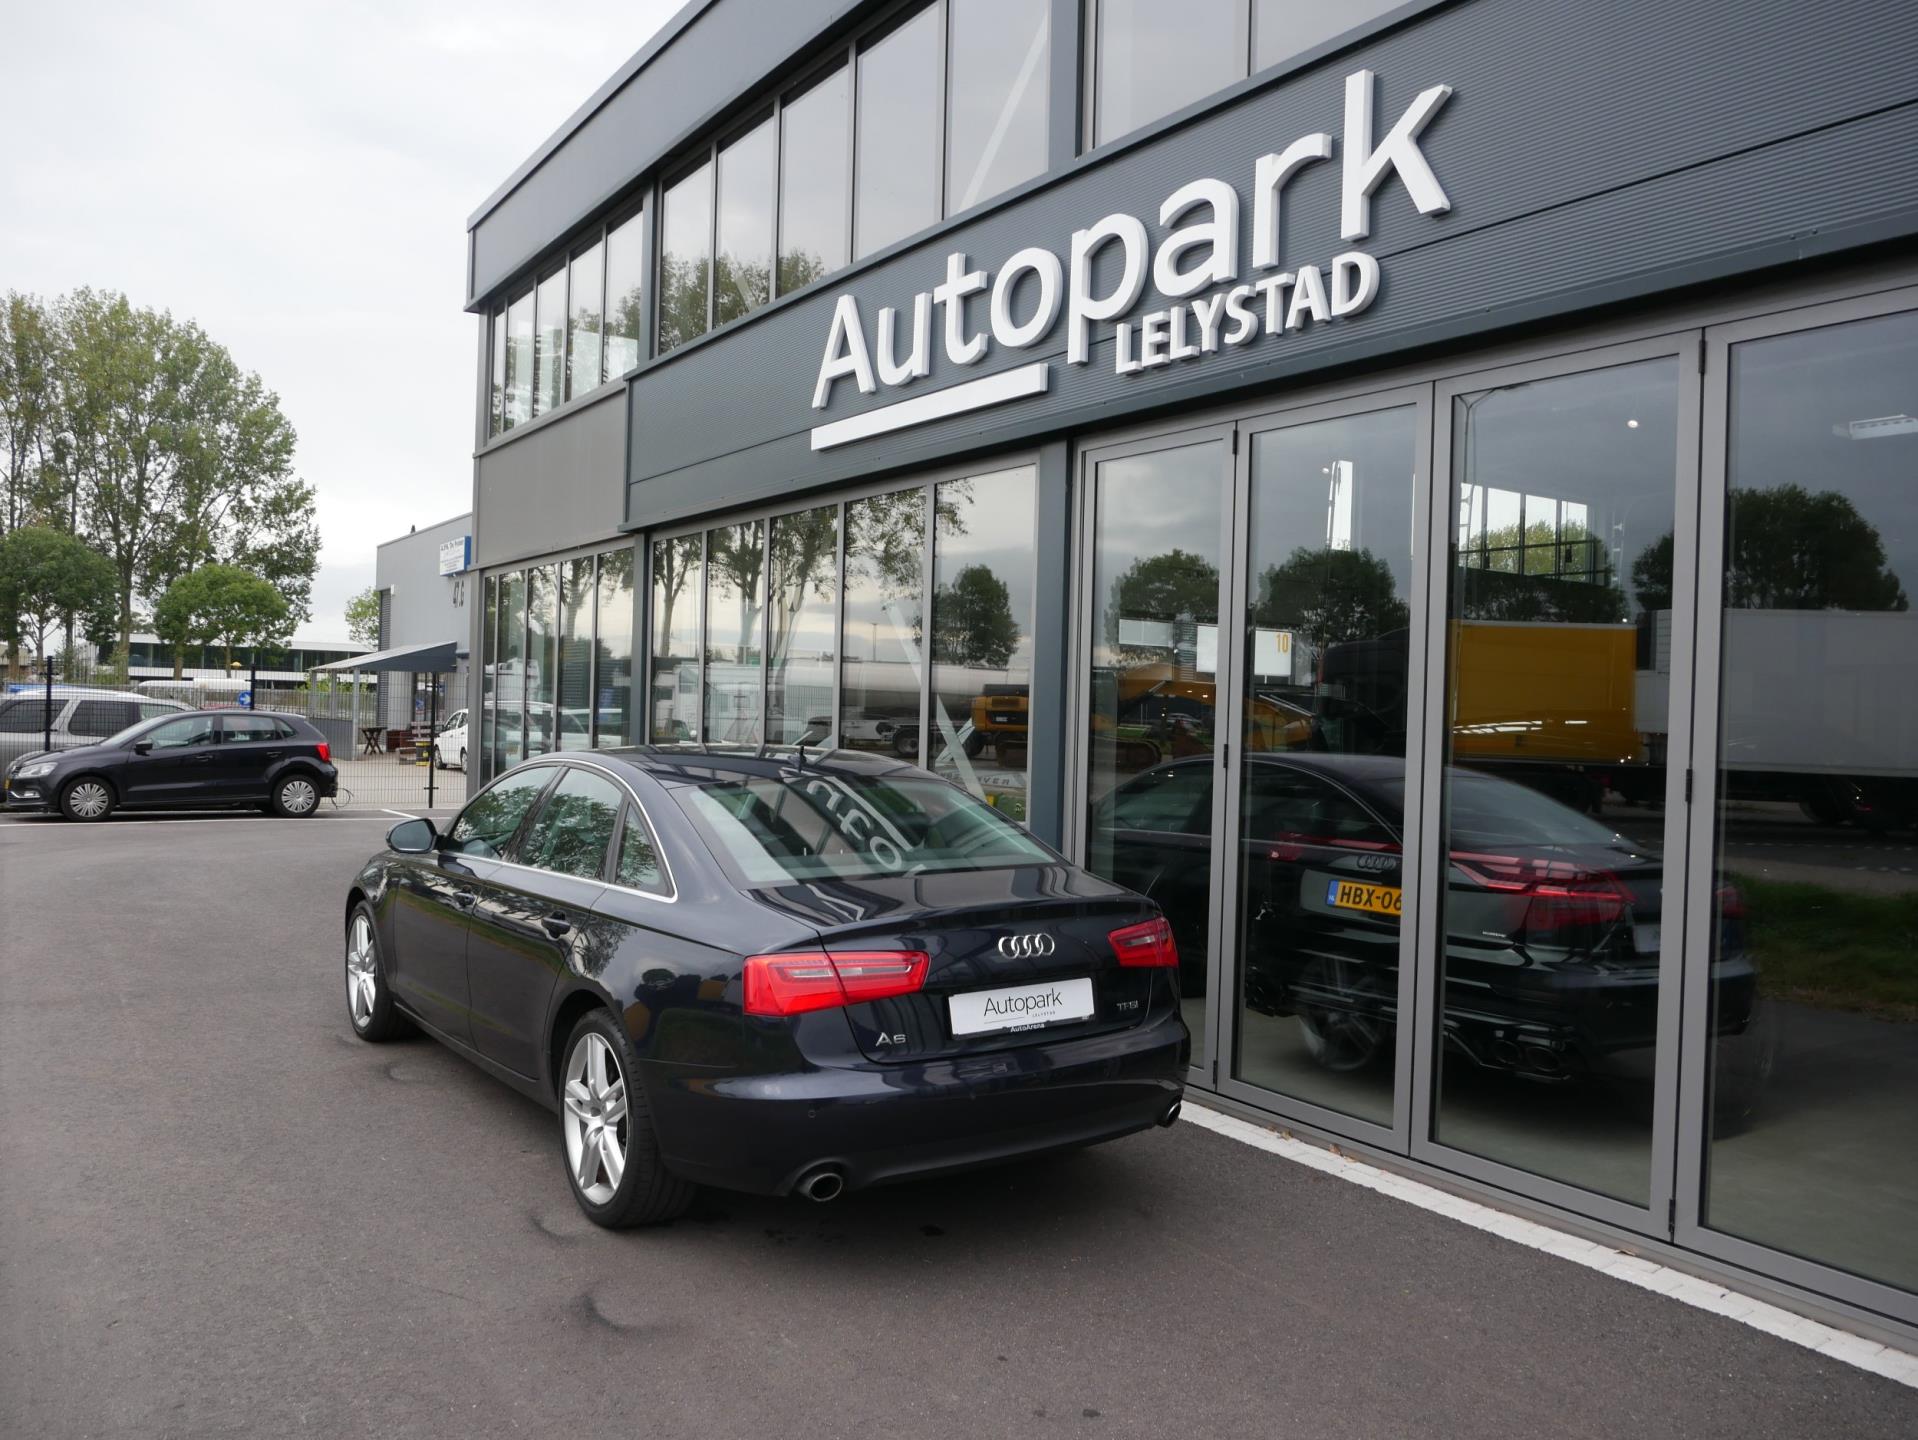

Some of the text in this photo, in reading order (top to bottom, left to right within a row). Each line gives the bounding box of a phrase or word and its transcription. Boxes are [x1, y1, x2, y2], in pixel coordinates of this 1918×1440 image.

[812, 69, 1453, 410] Autopark
[1115, 252, 1381, 375] LELYSTAD
[984, 988, 1063, 1017] Autopark
[875, 1031, 907, 1047] A6
[1010, 1023, 1046, 1033] AutoArena
